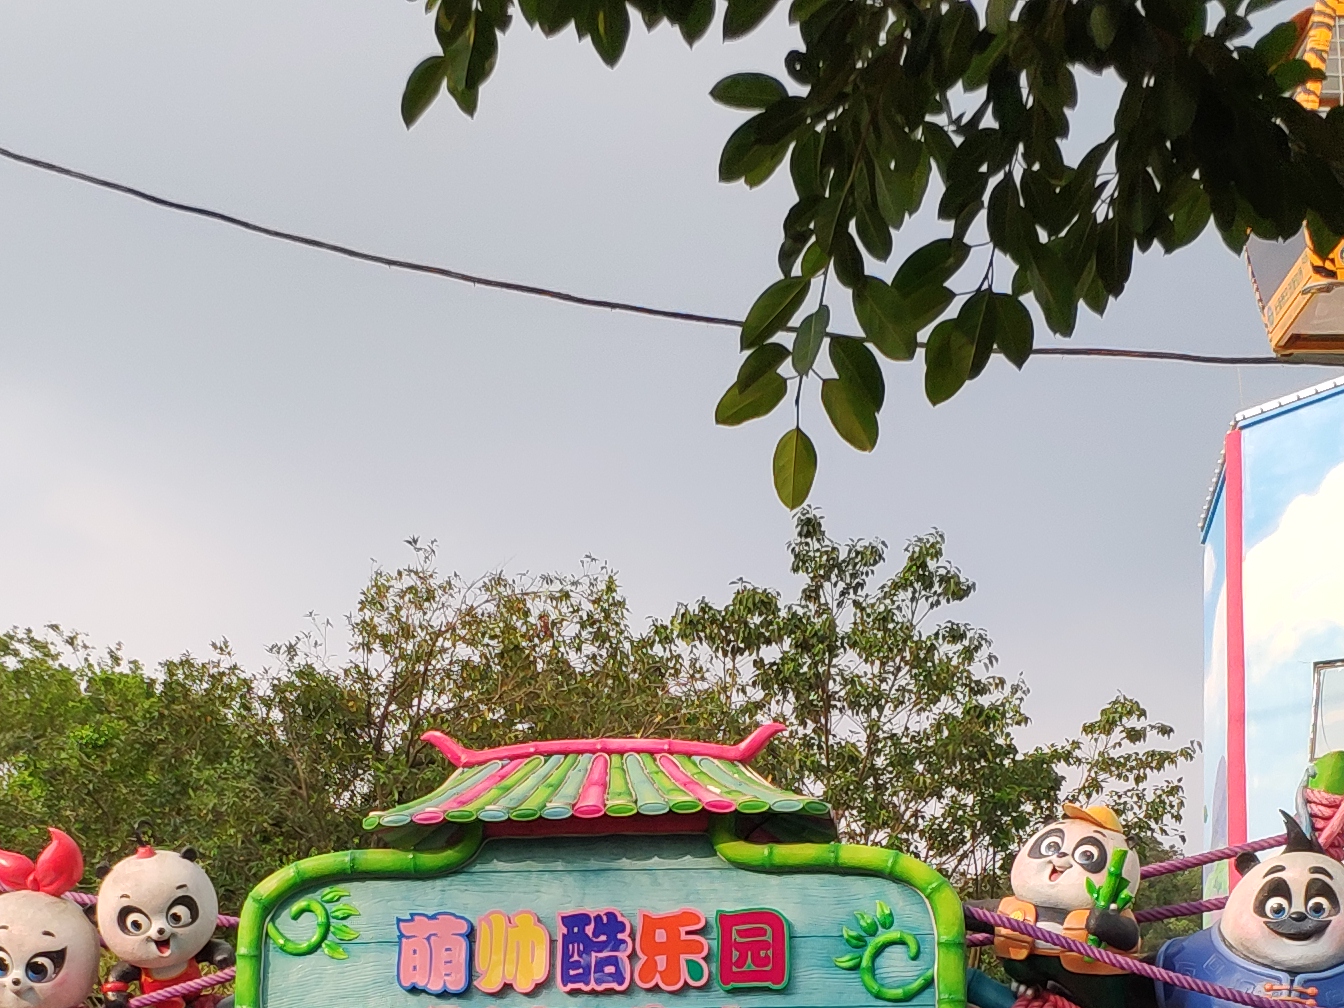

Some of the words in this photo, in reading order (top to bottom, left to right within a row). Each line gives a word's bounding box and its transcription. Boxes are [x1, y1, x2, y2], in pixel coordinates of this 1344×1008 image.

[396, 909, 792, 994] 萌帅酷乐园
